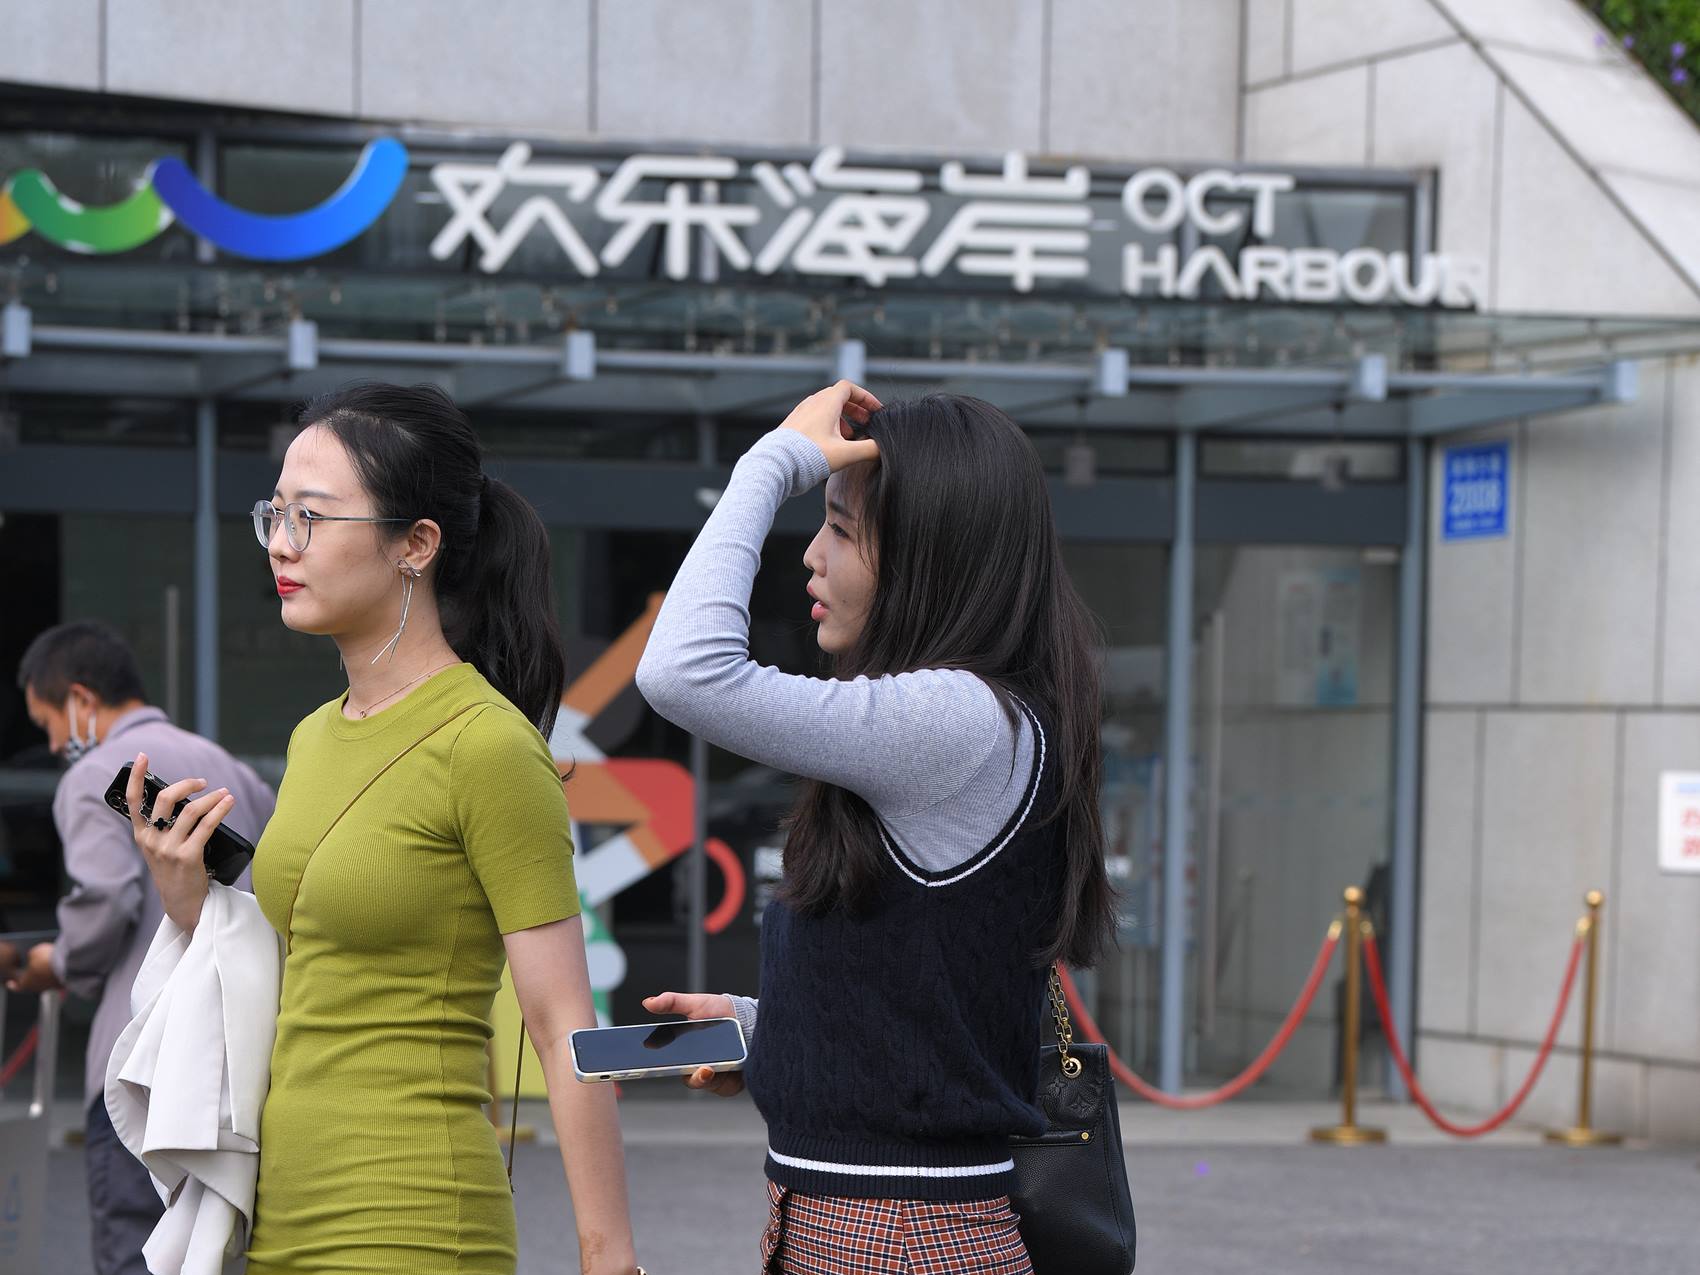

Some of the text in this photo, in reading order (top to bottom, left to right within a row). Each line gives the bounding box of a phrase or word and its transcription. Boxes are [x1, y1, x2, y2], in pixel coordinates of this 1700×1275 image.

[430, 142, 1092, 291] 欢乐海岸
[1122, 168, 1296, 238] OCT
[1122, 243, 1487, 312] HARBOUR
